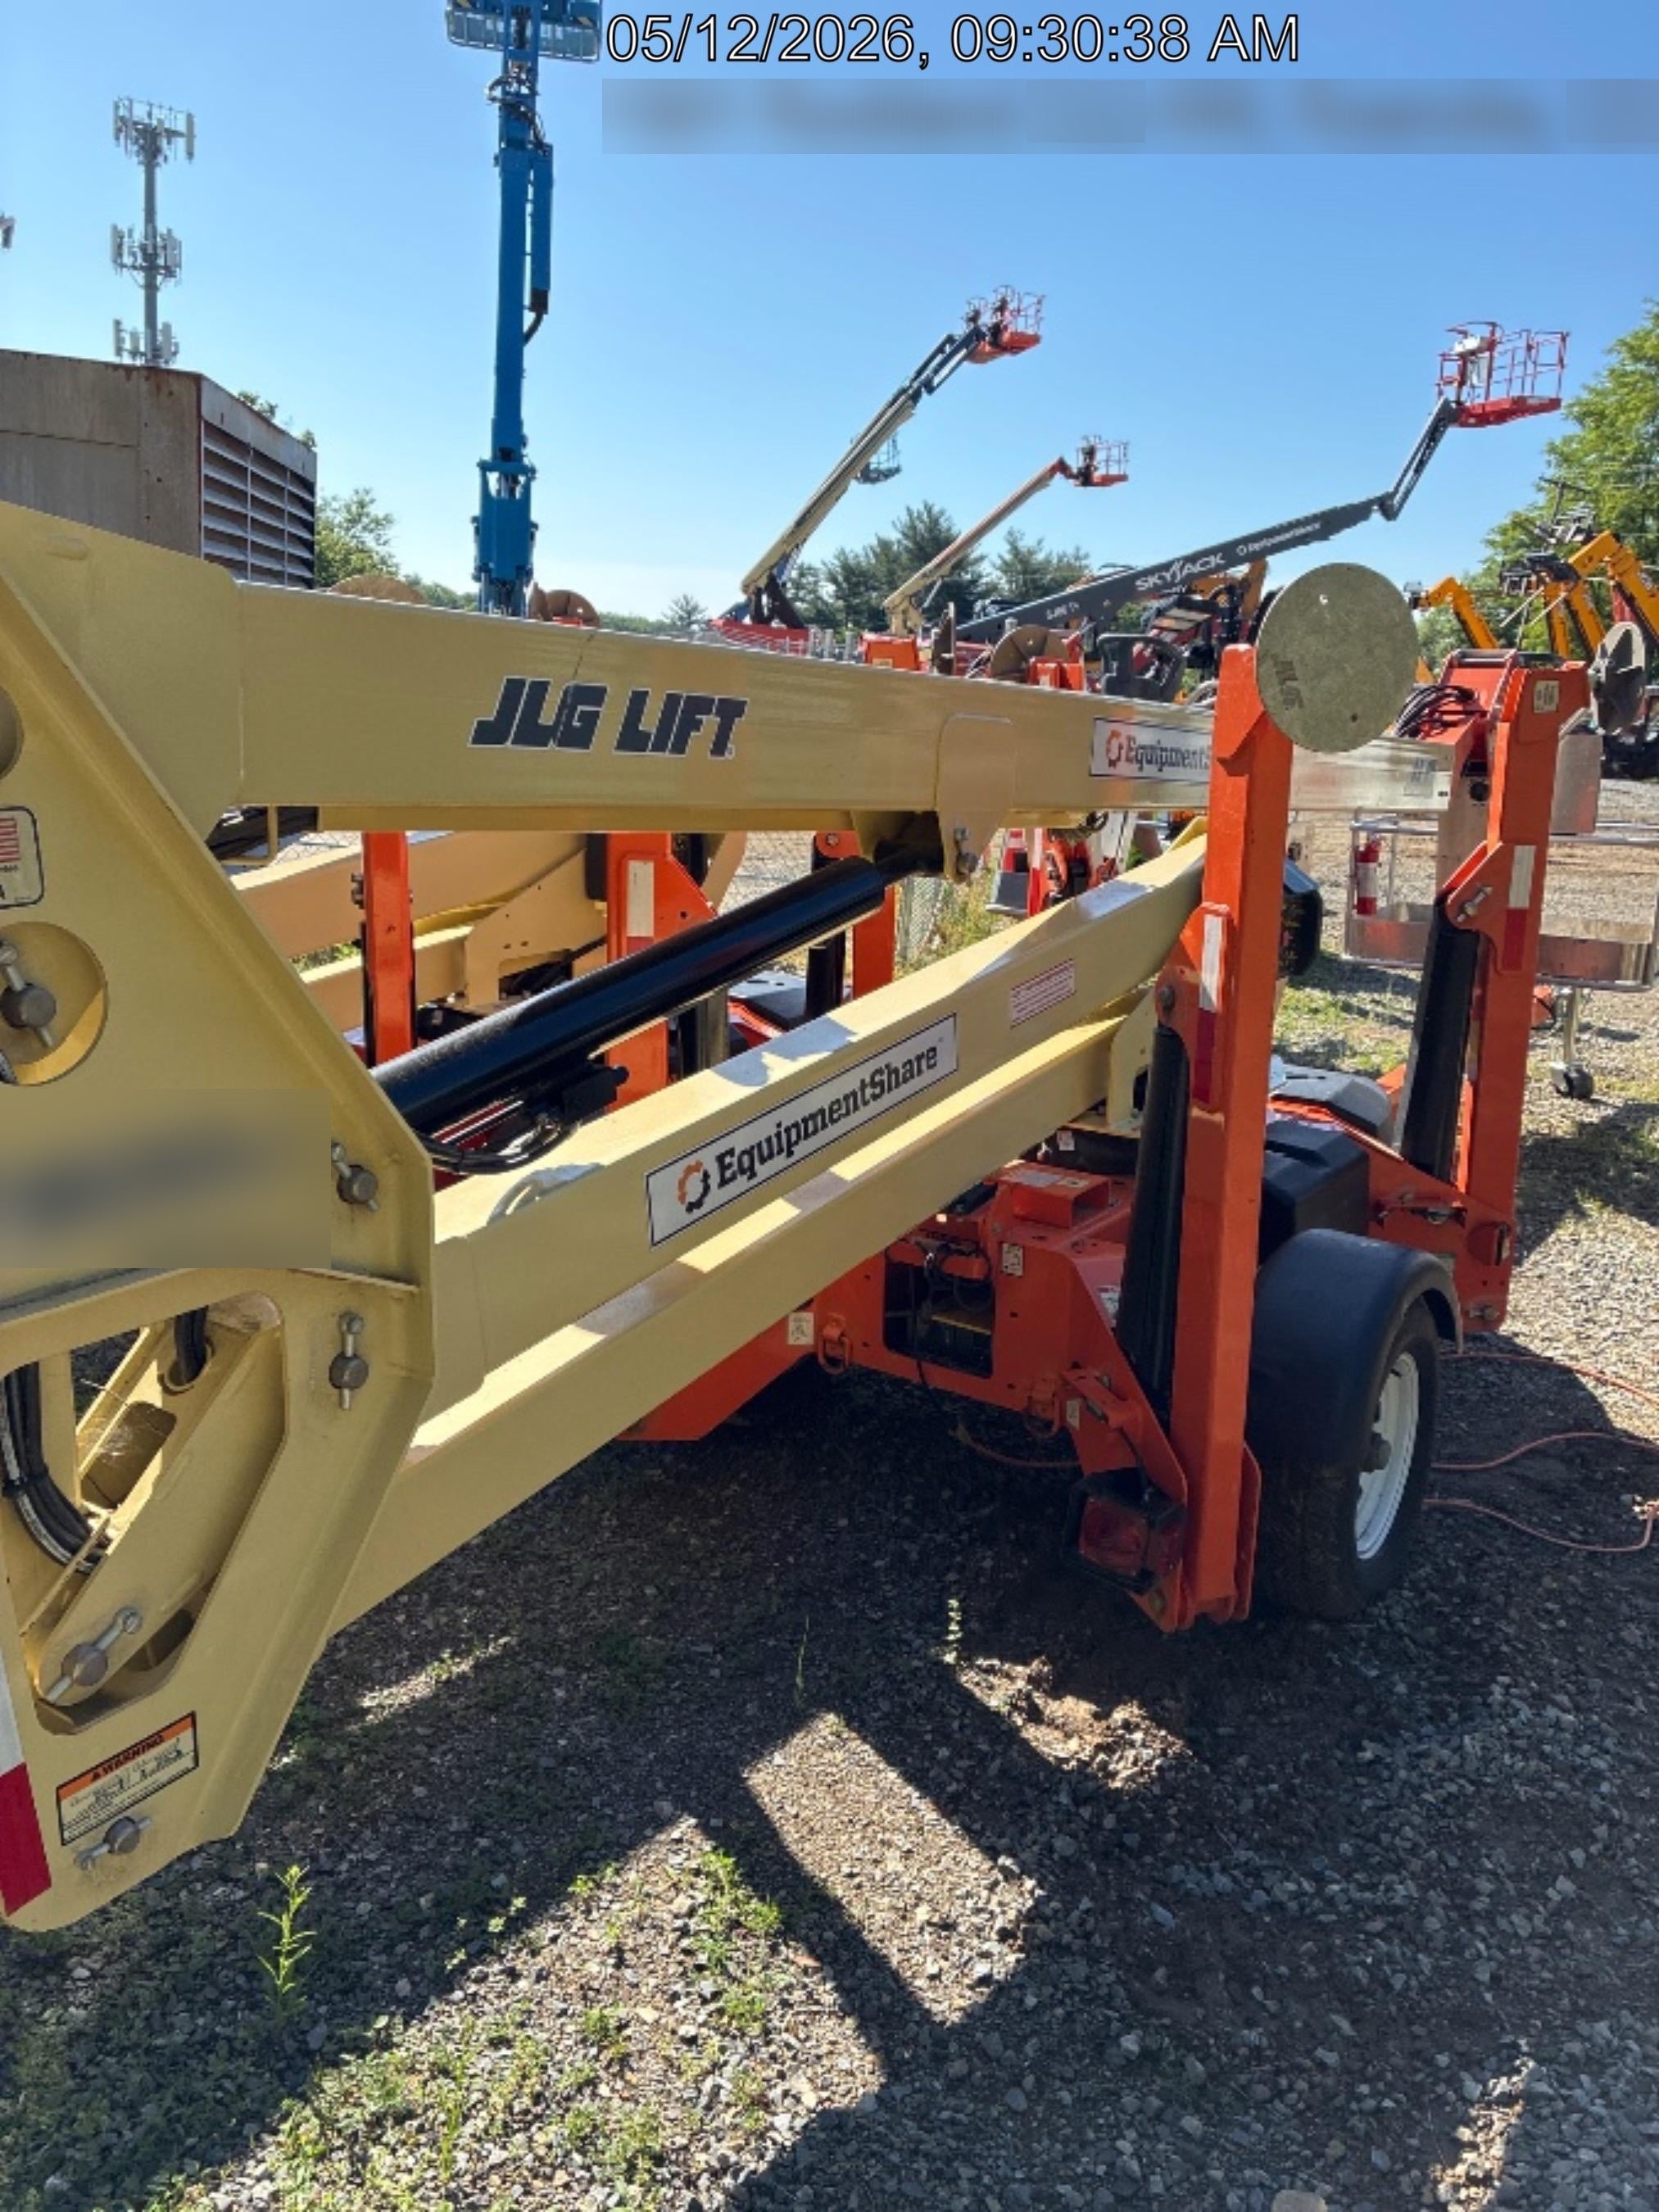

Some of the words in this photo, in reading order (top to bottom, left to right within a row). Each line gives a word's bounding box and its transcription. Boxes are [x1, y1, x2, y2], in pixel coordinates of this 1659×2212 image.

[1135, 552, 1226, 592] SKYJACK
[467, 675, 608, 753] JLG
[613, 688, 749, 759] LIFT
[715, 1045, 938, 1188] EquipmentShare
